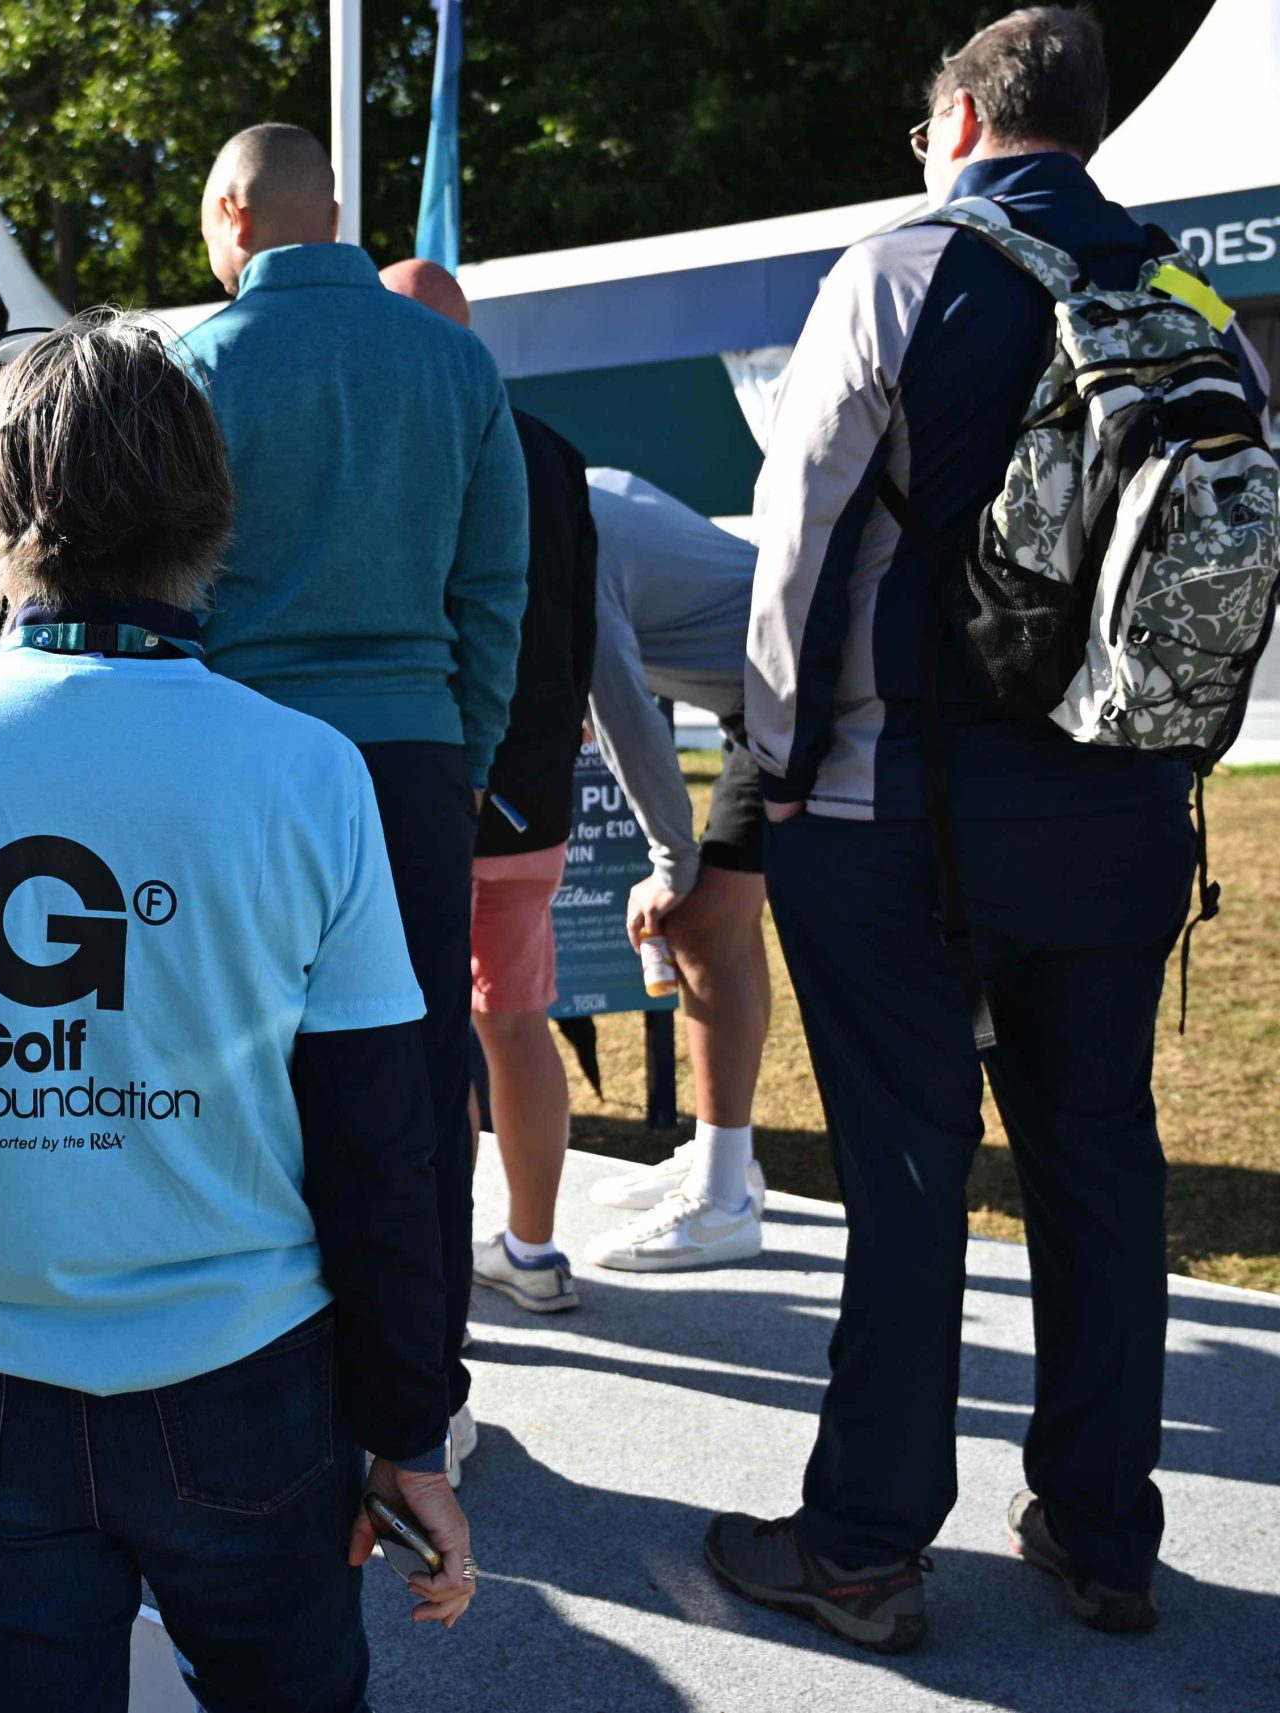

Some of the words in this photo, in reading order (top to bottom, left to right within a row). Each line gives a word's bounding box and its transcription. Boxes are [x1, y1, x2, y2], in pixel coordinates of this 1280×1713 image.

[1181, 216, 1280, 267] DES
[578, 822, 602, 840] for
[606, 820, 637, 838] £10
[41, 1136, 59, 1152] by
[63, 1136, 85, 1149] the
[90, 1132, 126, 1150] R&A
